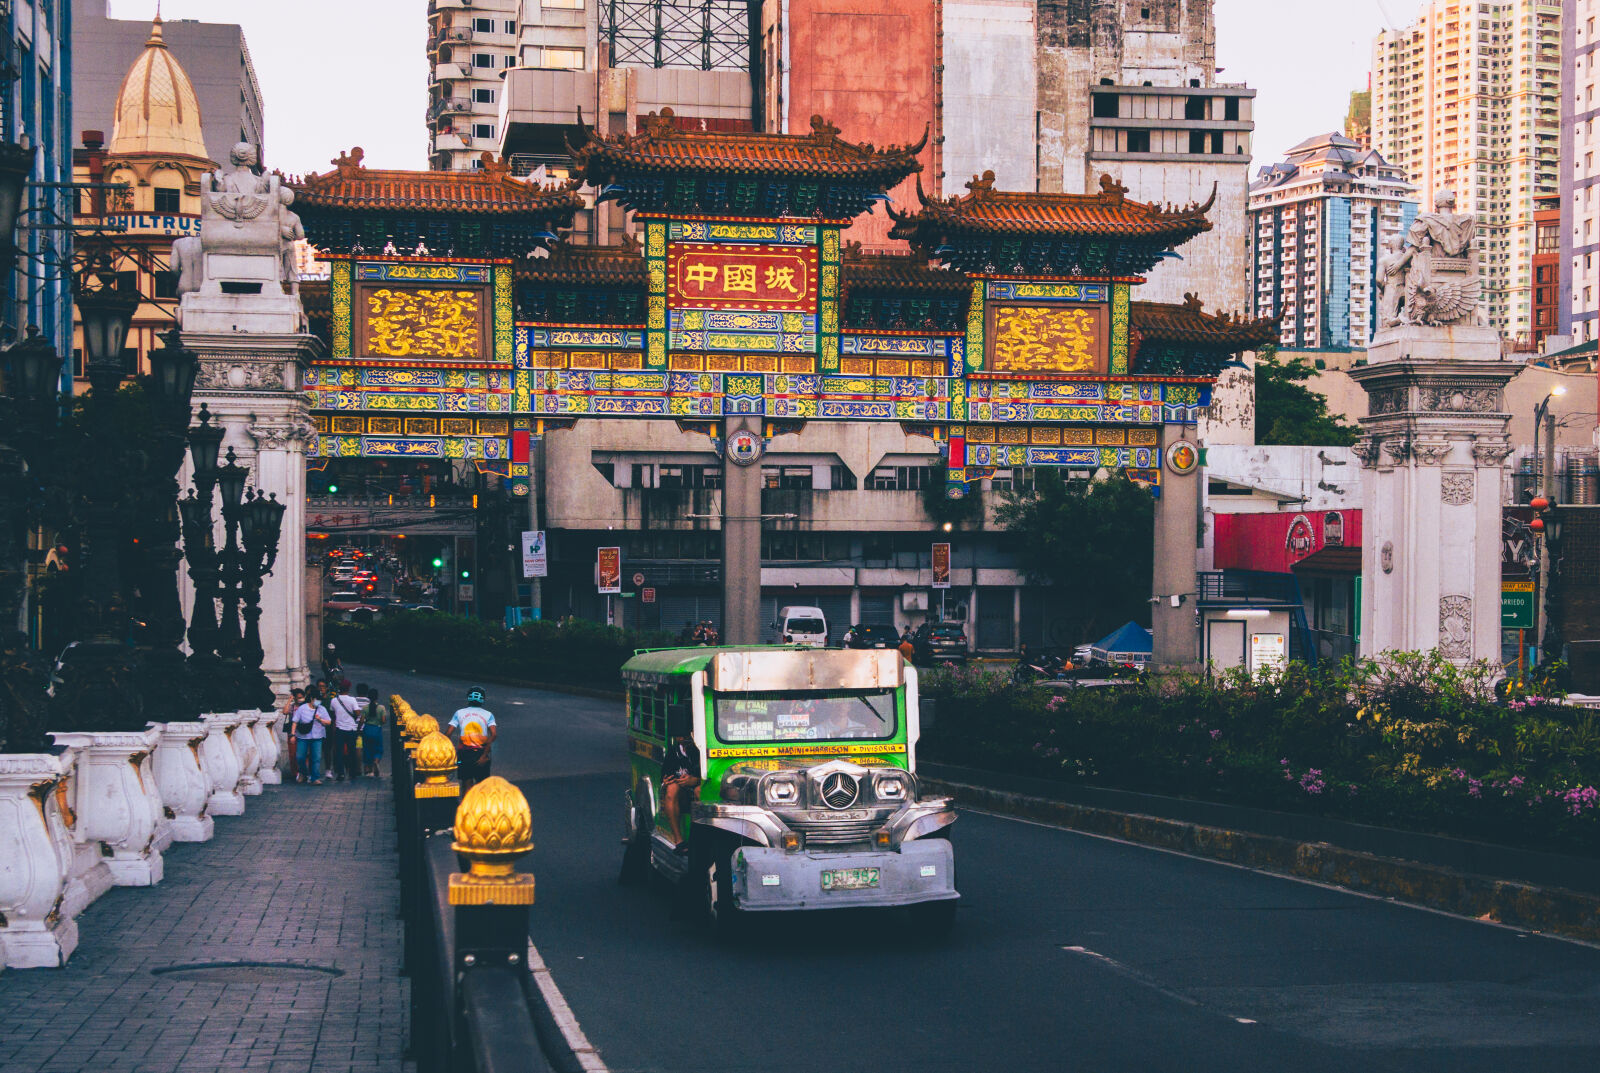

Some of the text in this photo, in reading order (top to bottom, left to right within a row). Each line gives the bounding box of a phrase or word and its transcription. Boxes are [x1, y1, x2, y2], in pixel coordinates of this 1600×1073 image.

[298, 272, 331, 281] ank
[685, 262, 800, 294] 中國城
[717, 749, 769, 757] BACLARAN
[860, 745, 897, 753] DIVISORIA
